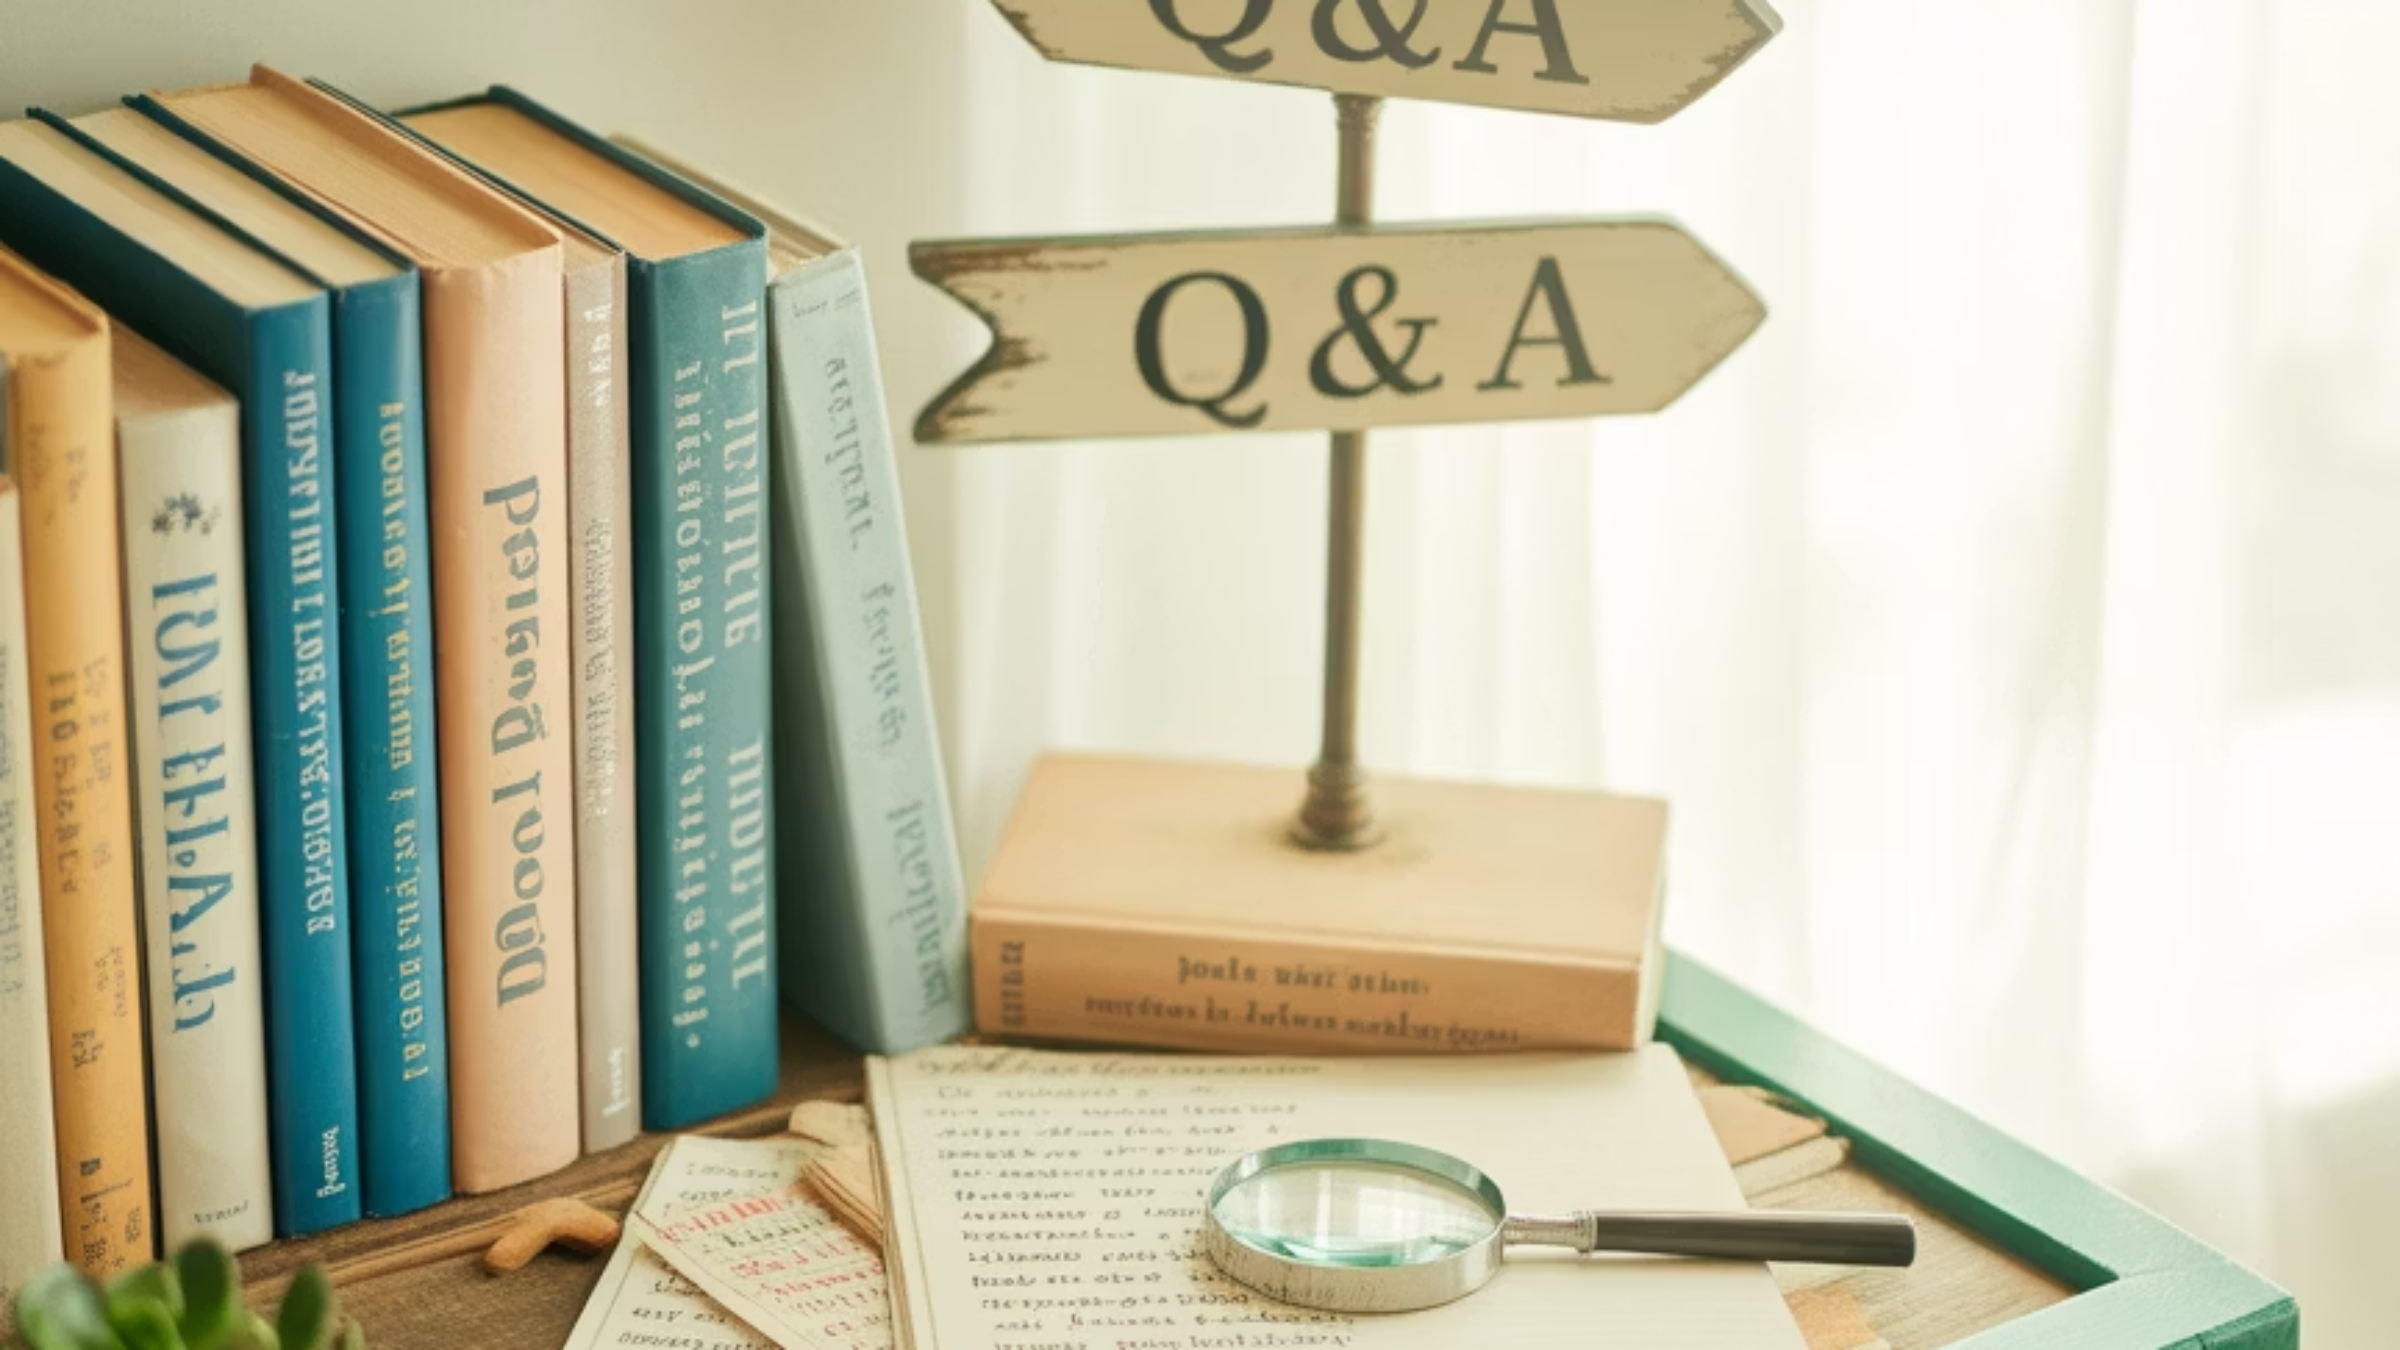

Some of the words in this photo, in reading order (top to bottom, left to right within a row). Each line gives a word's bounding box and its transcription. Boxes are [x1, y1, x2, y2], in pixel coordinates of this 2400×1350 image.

[1134, 271, 1270, 428] Q
[1308, 265, 1442, 399] &
[1477, 257, 1611, 391] A
